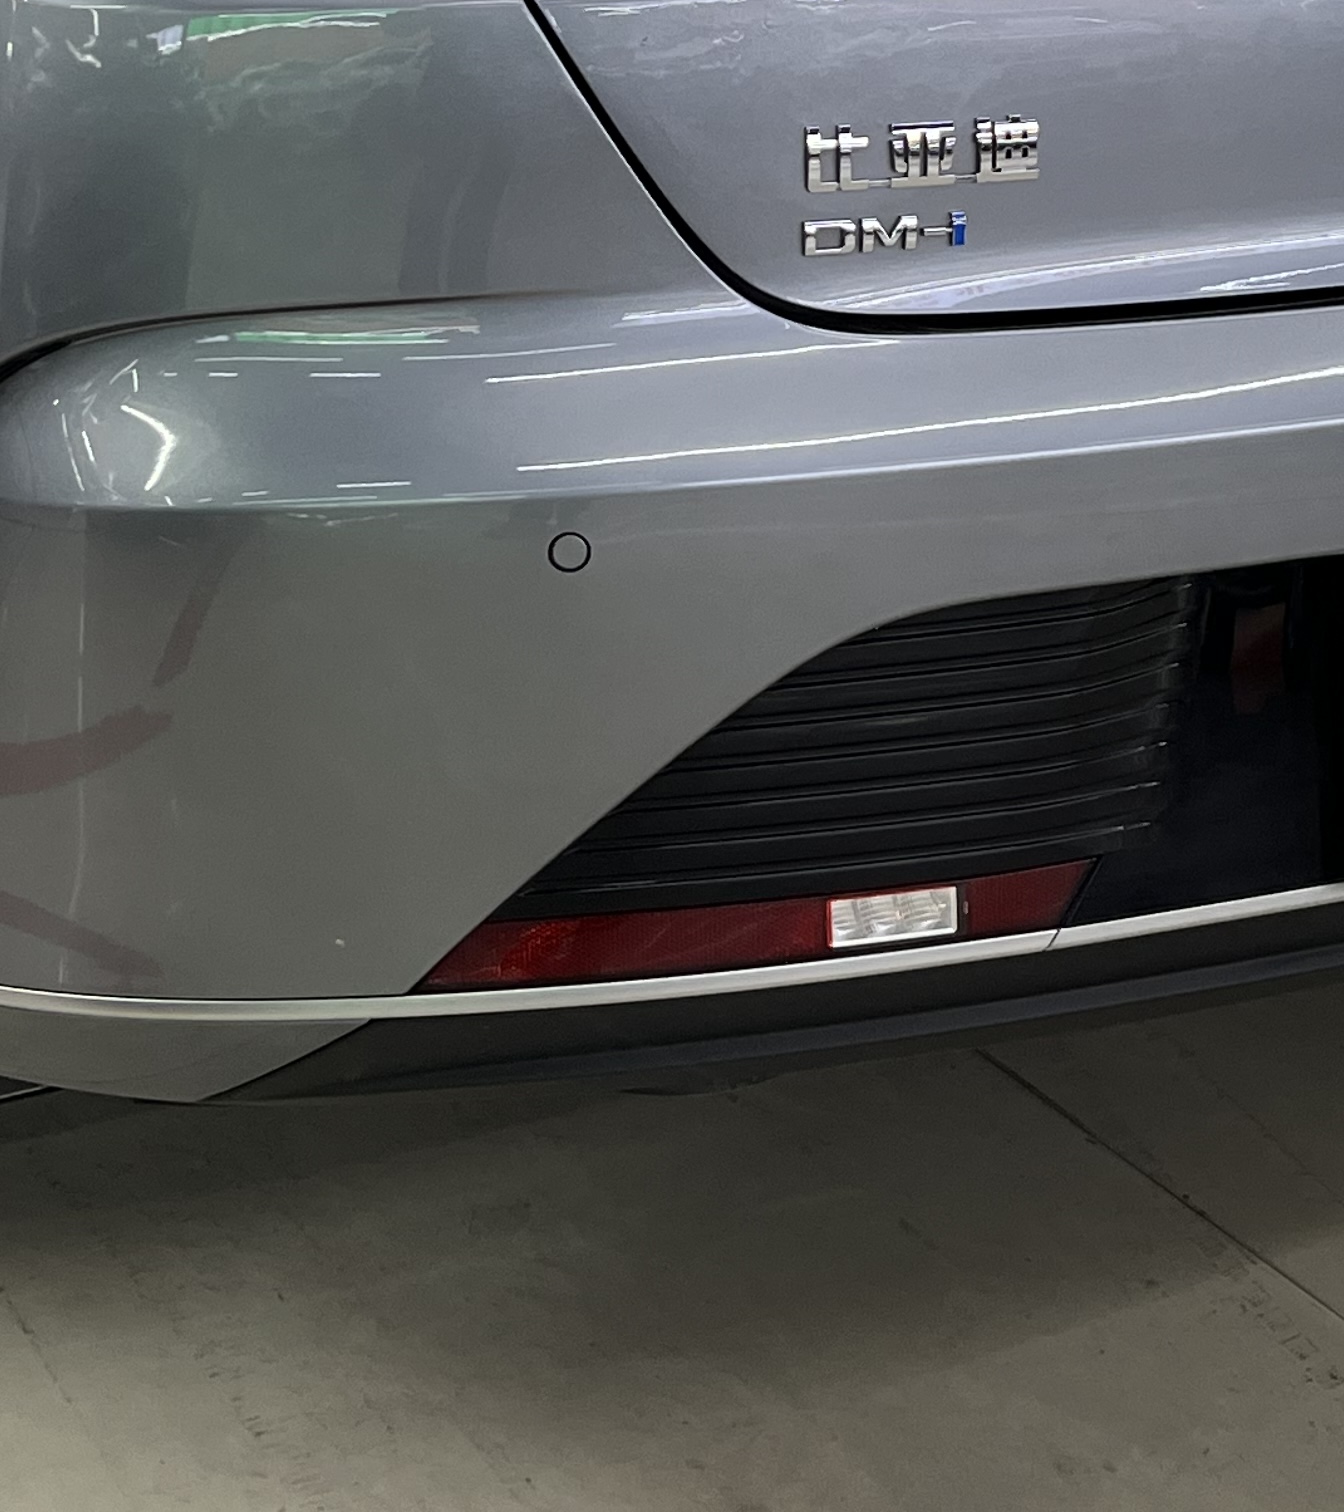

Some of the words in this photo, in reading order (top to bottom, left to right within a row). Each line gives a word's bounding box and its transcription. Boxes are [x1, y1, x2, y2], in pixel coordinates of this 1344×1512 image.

[806, 115, 1041, 193] 比亚迪
[802, 211, 968, 257] DM-i
